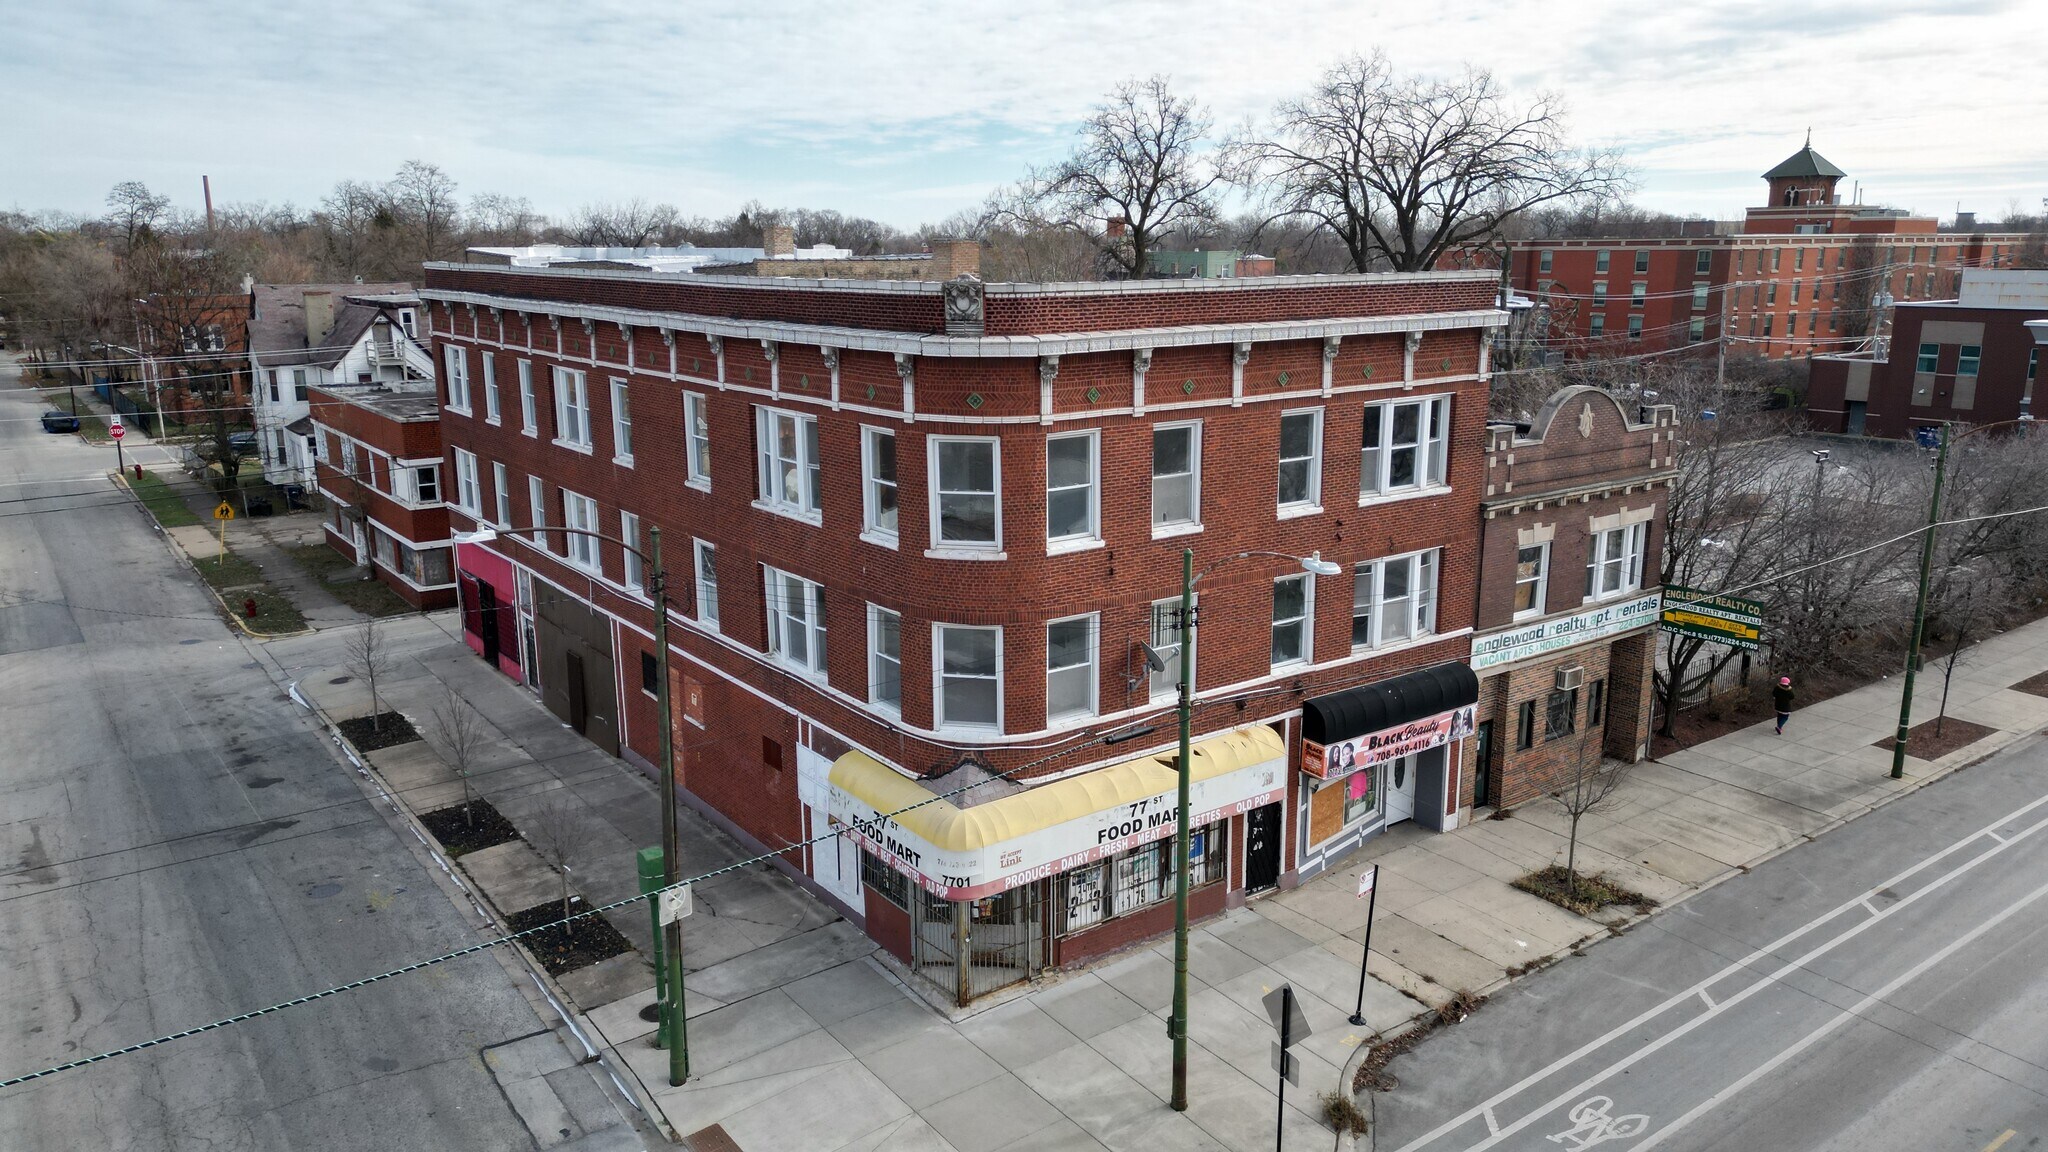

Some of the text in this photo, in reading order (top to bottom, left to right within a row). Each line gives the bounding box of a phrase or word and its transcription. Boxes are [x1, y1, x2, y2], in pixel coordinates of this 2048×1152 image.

[110, 428, 125, 436] STOP
[1665, 589, 1761, 616] ENGLEWOOD REALTY CO.
[1698, 606, 1720, 616] REALTY
[1734, 613, 1760, 625] RENTALS
[1475, 625, 1545, 656] englewood
[1548, 617, 1587, 635] realty
[1590, 609, 1612, 627] apt.
[1615, 596, 1658, 619] rentals
[1479, 650, 1511, 667] VACANT
[1539, 635, 1571, 651] HOUSES
[1368, 732, 1405, 751] BLACK
[1404, 719, 1440, 741] Beauty
[1376, 738, 1431, 763] 708-969-4116
[1130, 795, 1164, 818] 77 ST
[873, 811, 899, 831] 77 ST
[1098, 818, 1143, 844] FOOD
[852, 813, 883, 844] FOOD
[887, 835, 921, 867] MART
[1005, 863, 1051, 889] PRODUCE
[1061, 850, 1090, 871] DAIRY
[1099, 838, 1128, 858] FRESH
[1137, 829, 1161, 845] MEAT
[1169, 809, 1221, 834] CIRETTES
[1236, 801, 1252, 813] OLD
[1254, 793, 1271, 808] POP
[880, 847, 892, 864] MEAT
[894, 858, 920, 884] CIGARETTES
[925, 878, 935, 893] OLD
[935, 883, 948, 899] POP
[1000, 854, 1022, 869] Link
[942, 874, 971, 888] 7701
